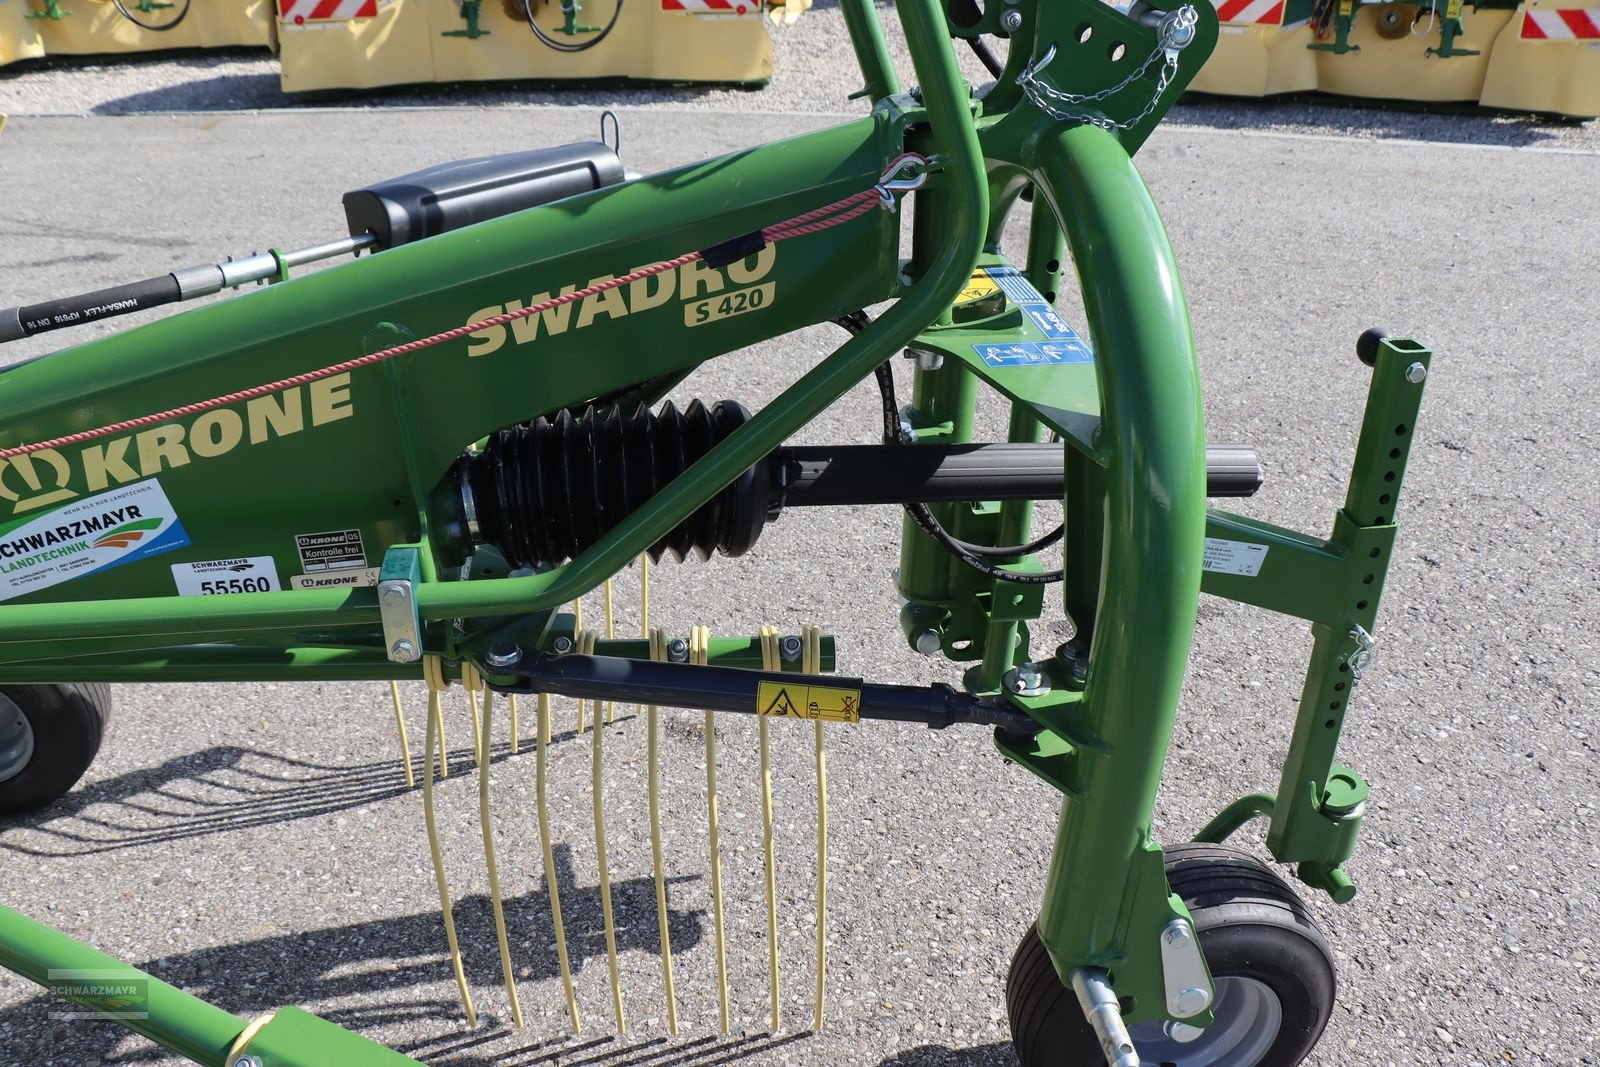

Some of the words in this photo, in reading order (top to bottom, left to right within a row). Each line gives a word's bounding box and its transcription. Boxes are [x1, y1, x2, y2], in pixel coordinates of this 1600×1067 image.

[84, 298, 138, 317] HANSA-FLEX
[466, 241, 776, 358] SWADRO
[695, 302, 710, 323] S
[717, 288, 763, 315] 420
[38, 318, 51, 327] DN
[81, 371, 354, 492] KRONE
[64, 507, 81, 516] MEHR
[95, 498, 108, 506] NUR
[0, 505, 143, 560] CHWARZMAYR
[310, 535, 345, 545] KRONE
[0, 540, 91, 574] LANDTECHNIK
[305, 546, 343, 558] Kontrolle
[345, 545, 359, 554] frei
[191, 558, 248, 569] SCHWARZMAYR
[201, 576, 271, 595] 55560
[315, 576, 358, 586] KRONE
